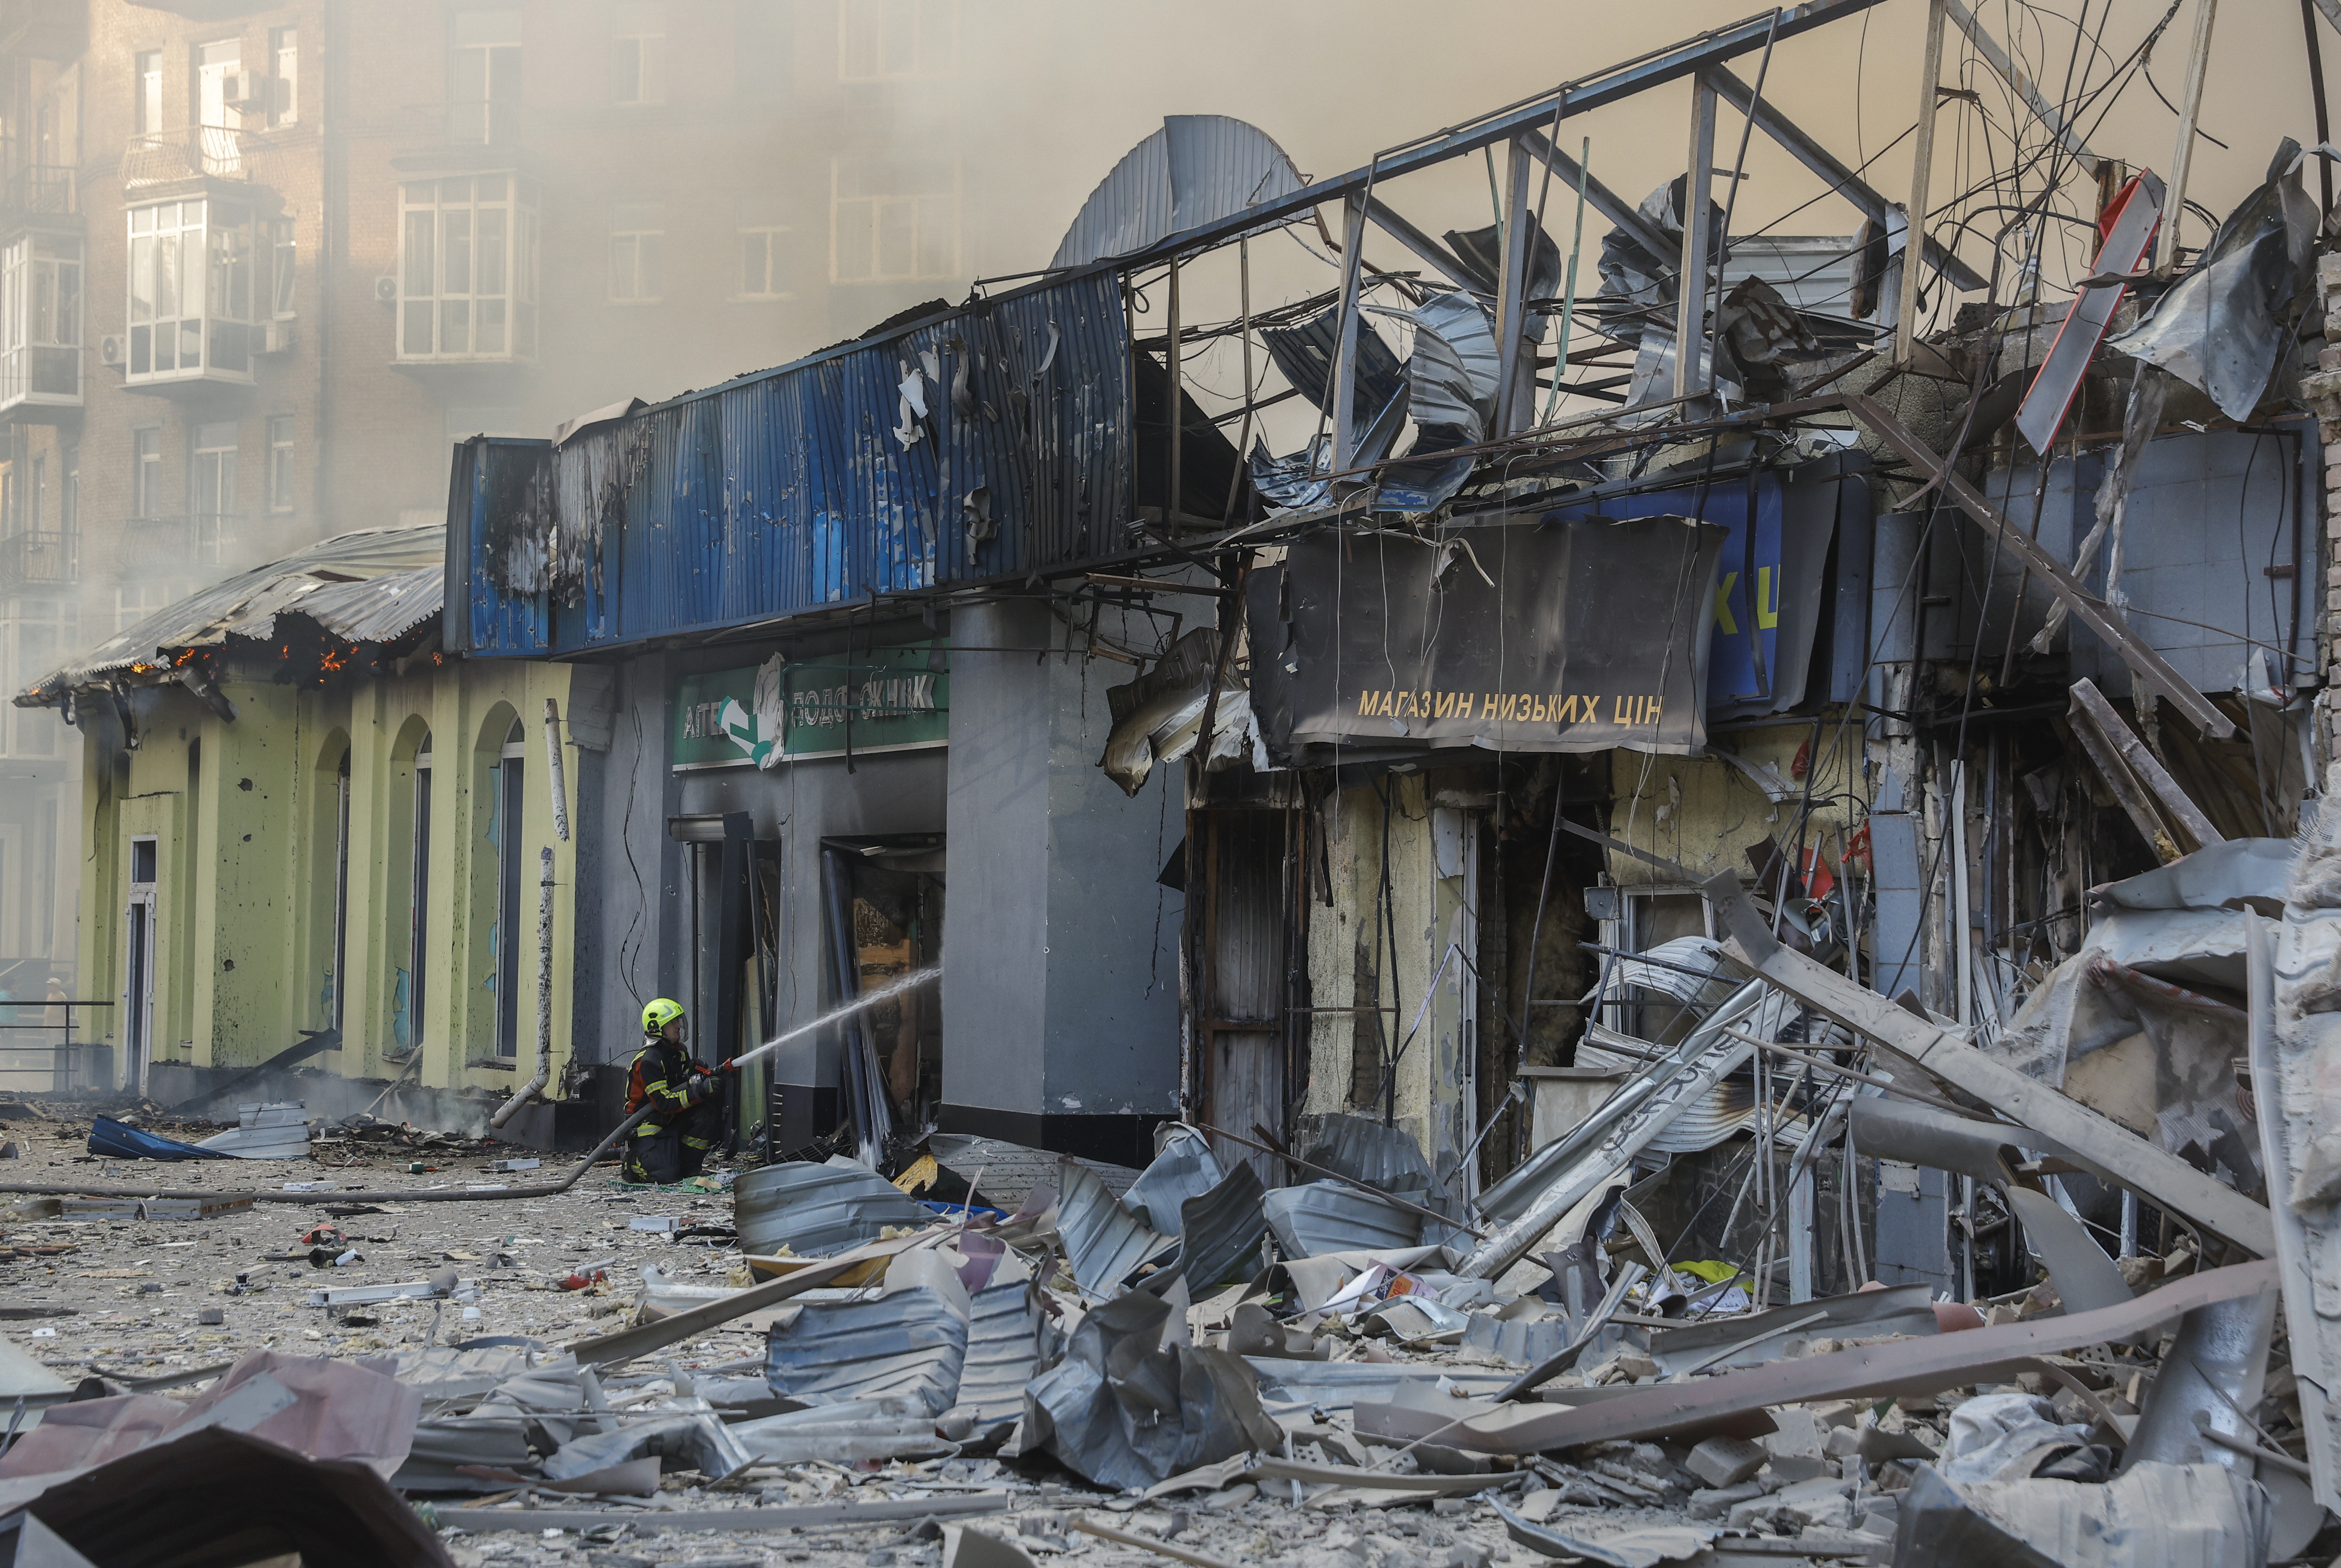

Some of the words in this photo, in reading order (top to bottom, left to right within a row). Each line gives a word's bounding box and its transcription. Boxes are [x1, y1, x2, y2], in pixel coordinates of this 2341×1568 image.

[1358, 690, 1474, 719] МАГАЗИН
[1480, 693, 1600, 723] НИЗЬКИХ
[1613, 695, 1664, 729] ЦІН
